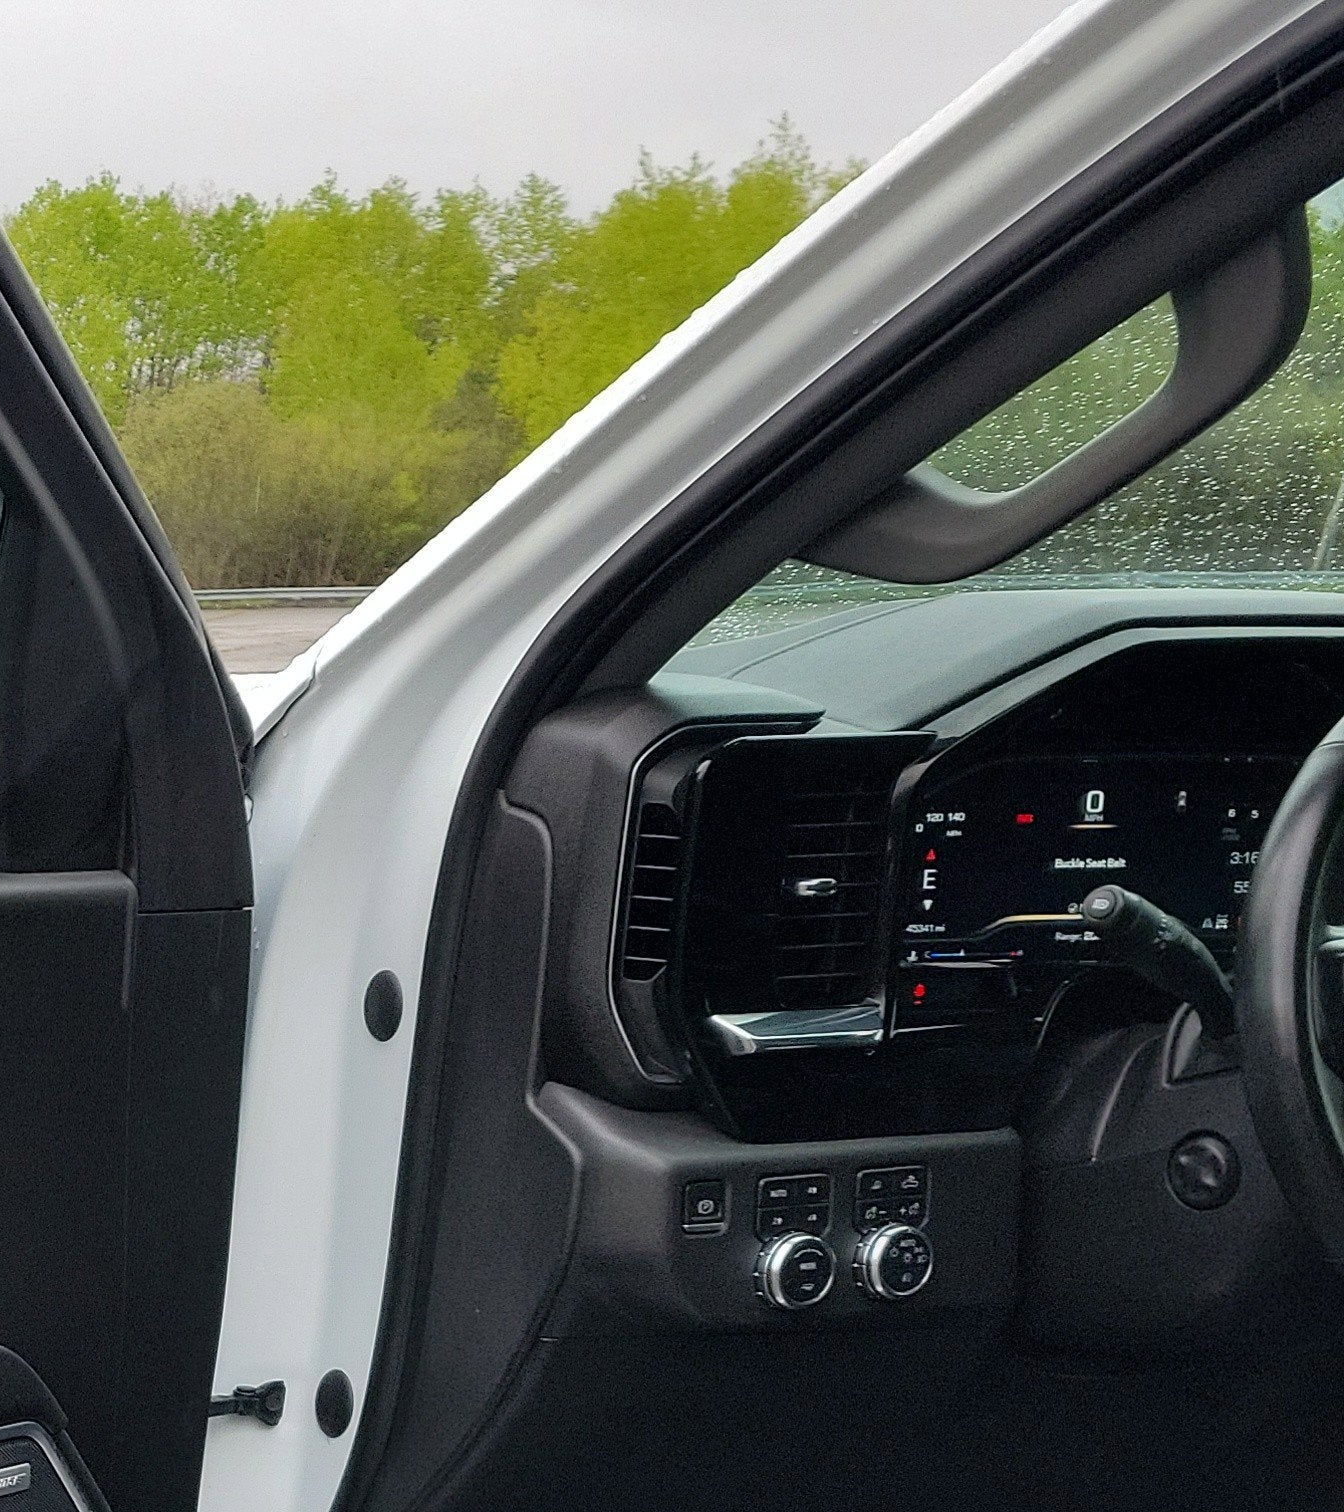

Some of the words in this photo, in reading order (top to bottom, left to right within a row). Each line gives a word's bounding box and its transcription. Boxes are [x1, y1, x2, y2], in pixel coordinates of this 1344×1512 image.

[1086, 790, 1105, 813] 0
[1054, 858, 1085, 869] Buckle
[1086, 858, 1106, 868] Seat
[1107, 858, 1127, 868] Belt
[922, 869, 938, 890] E
